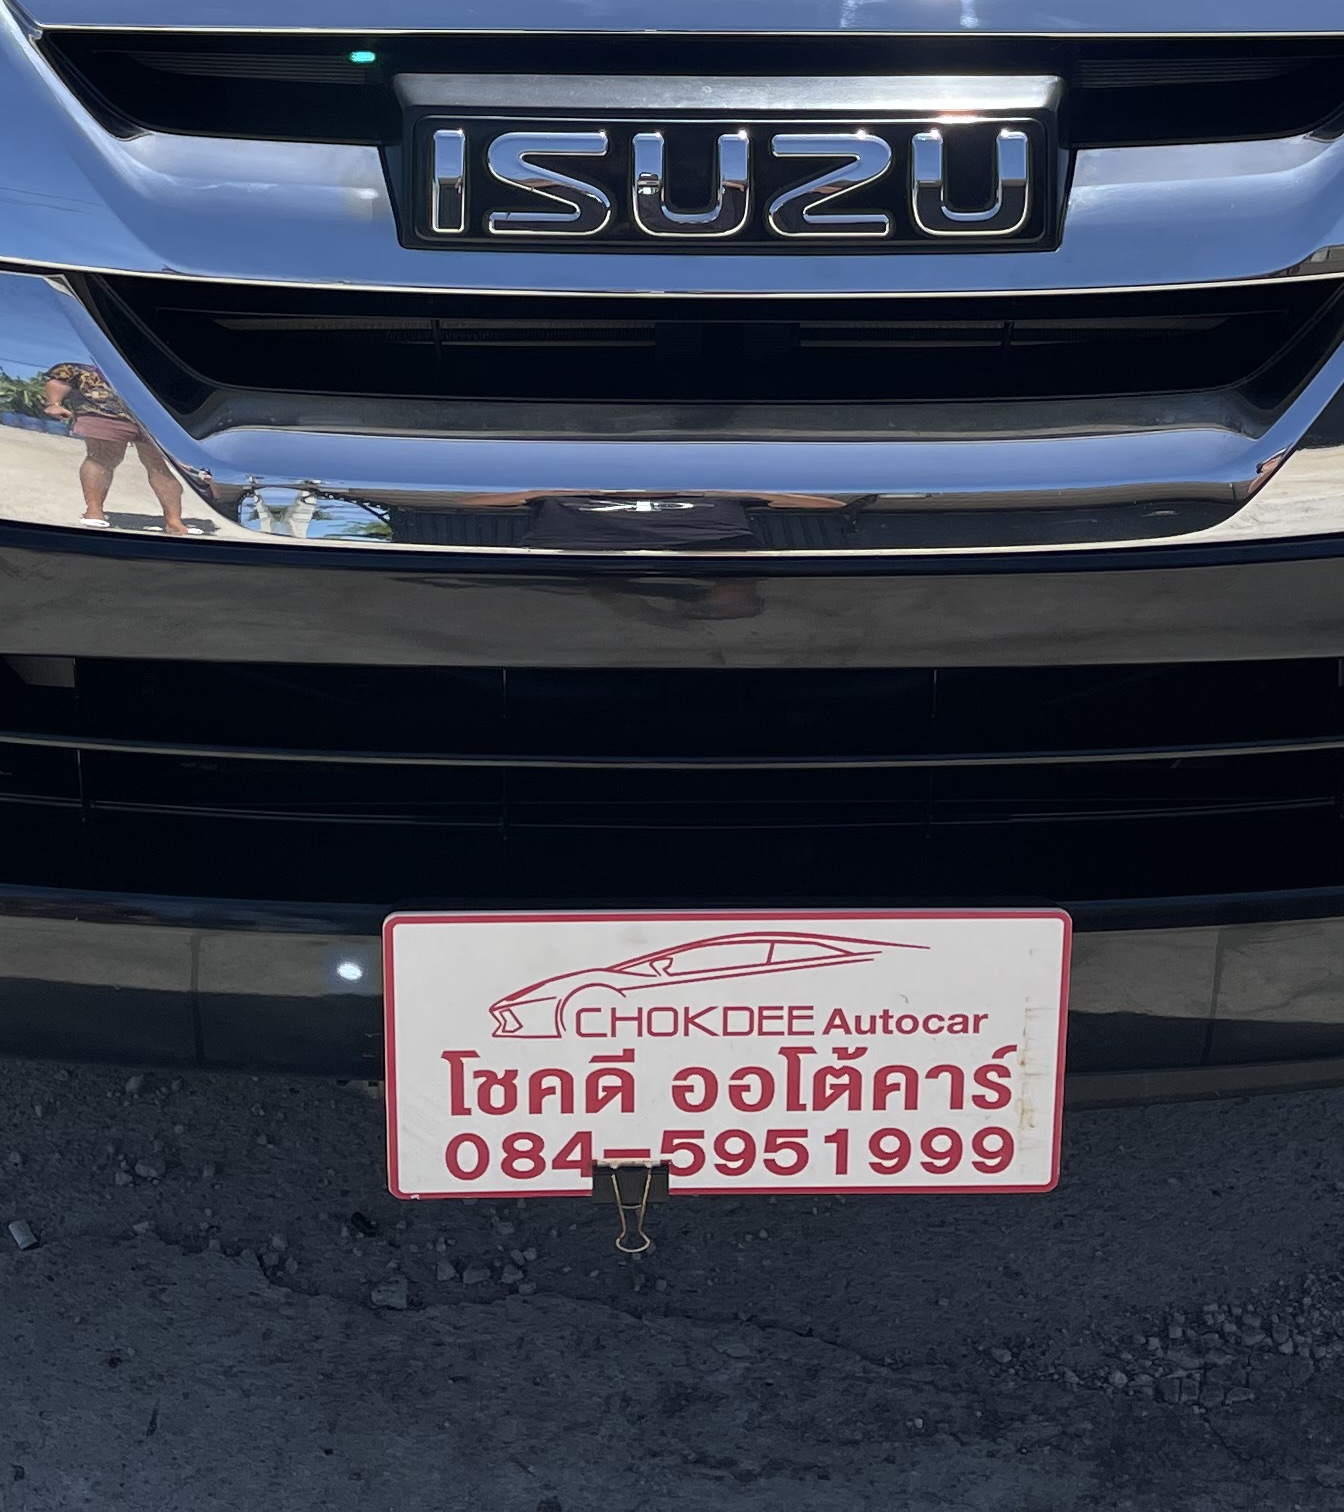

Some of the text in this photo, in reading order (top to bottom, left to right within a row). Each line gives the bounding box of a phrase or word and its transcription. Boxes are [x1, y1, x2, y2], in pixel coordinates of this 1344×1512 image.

[431, 128, 1030, 237] ISUZU
[574, 1005, 989, 1037] CHOKDEE Autocar
[441, 1044, 1019, 1116] โชคดี ออโต้คาร์
[444, 1125, 1016, 1181] 084-5951999
